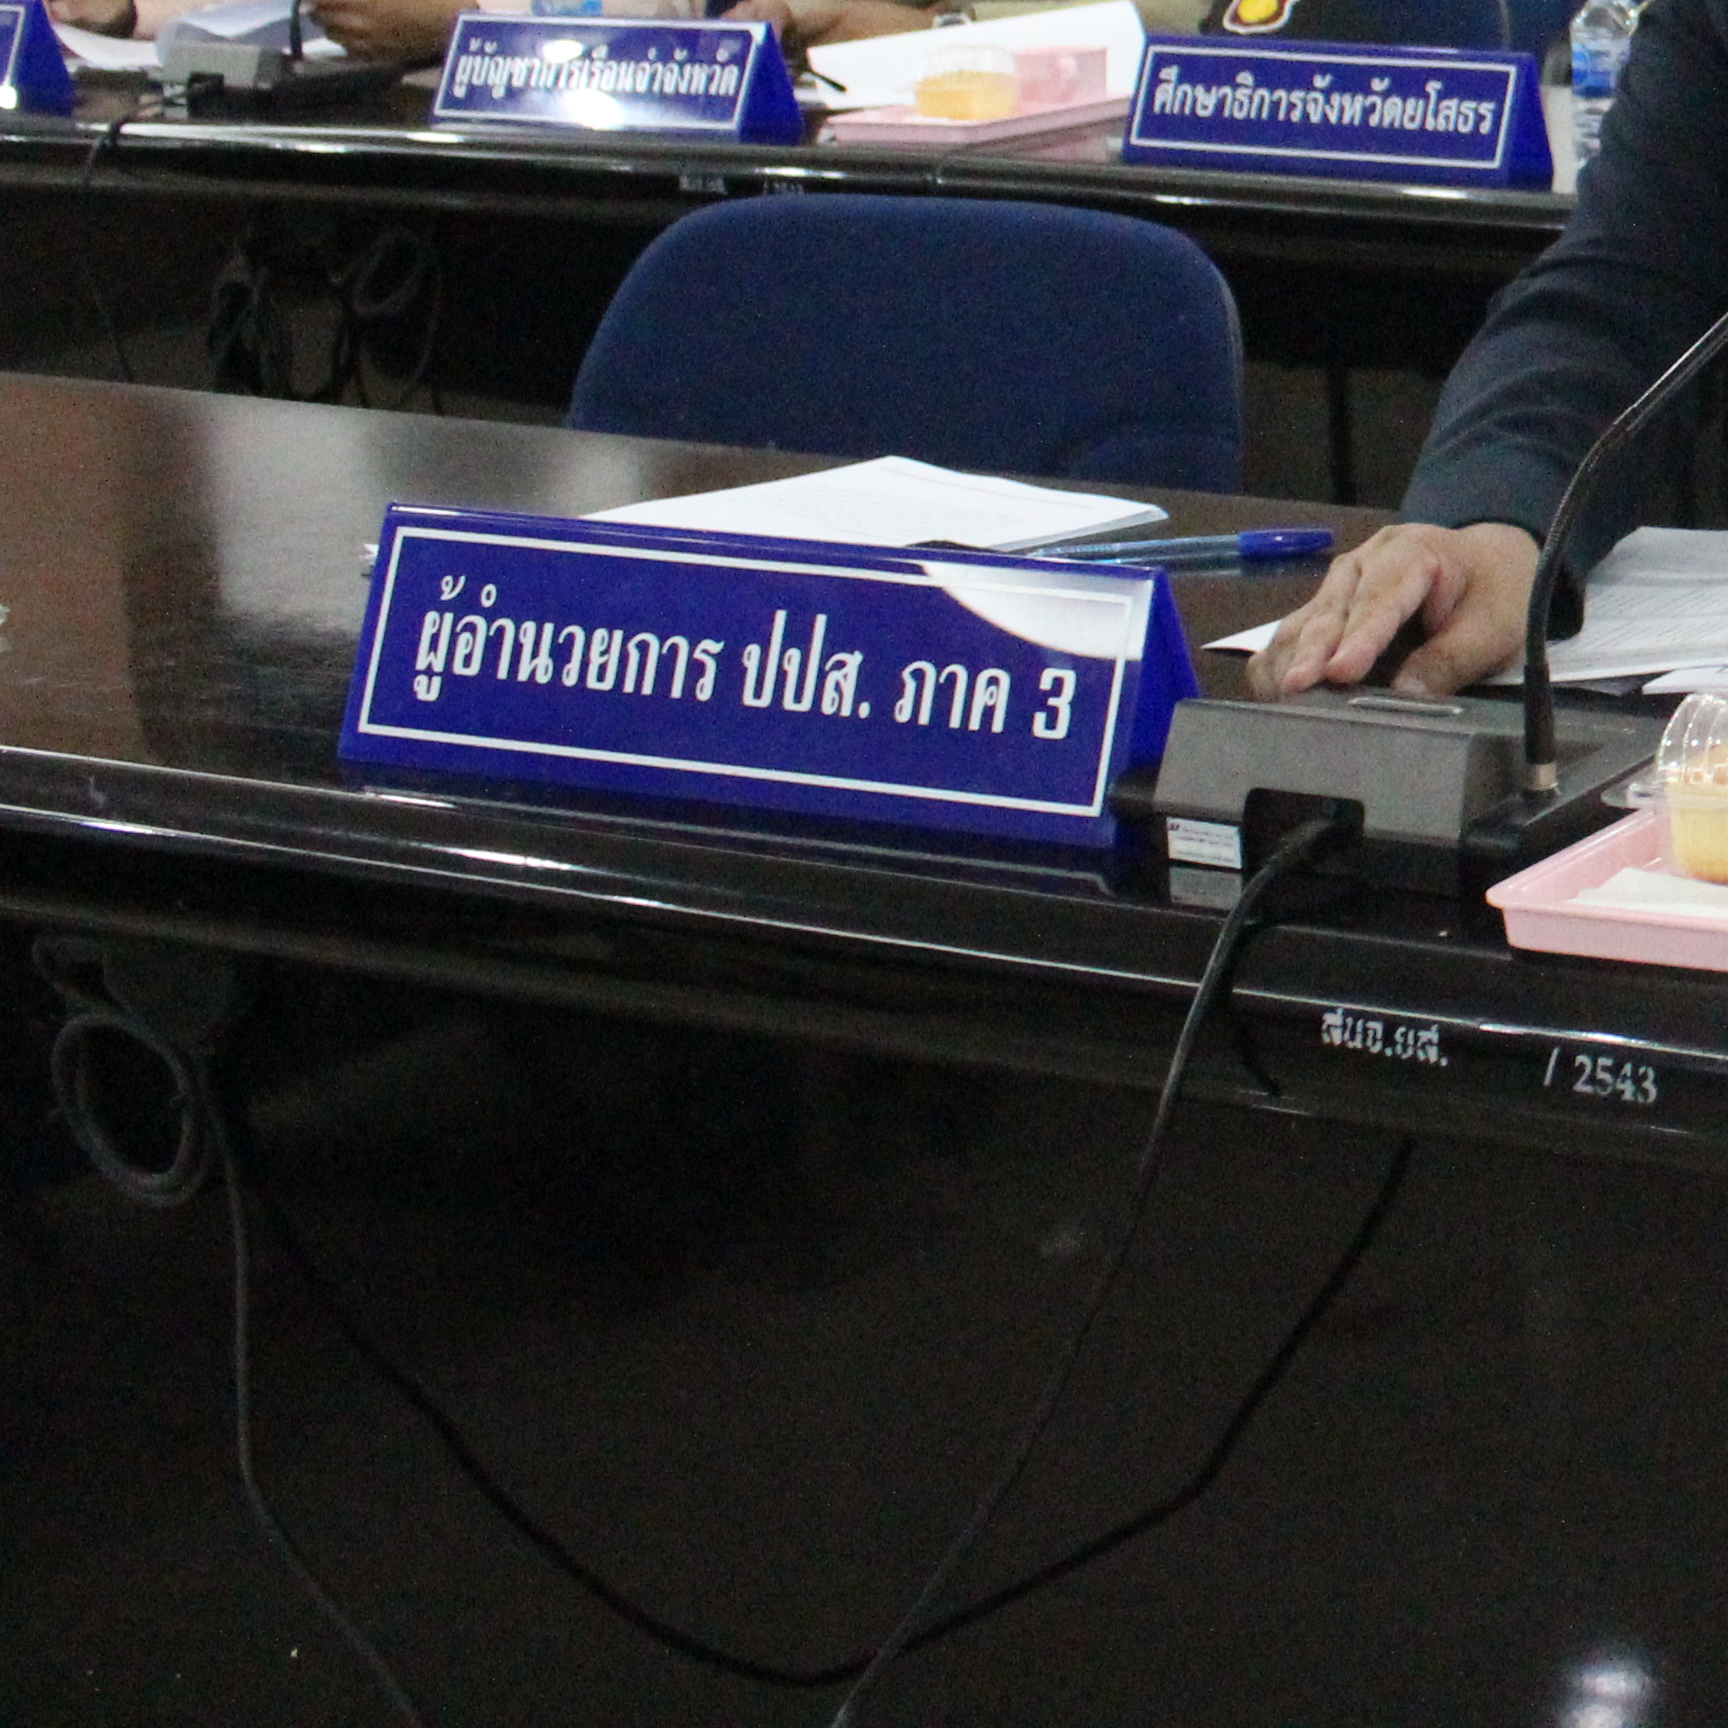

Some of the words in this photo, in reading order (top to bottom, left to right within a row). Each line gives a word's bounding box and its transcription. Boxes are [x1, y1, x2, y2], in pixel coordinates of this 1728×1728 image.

[453, 37, 739, 99] ผู้บัญชาการเรือนจำจังหวัด
[1152, 65, 1497, 135] ศึกษาธิการจังหวัดยโสธร
[413, 574, 723, 703] ผู้อำนวยการ
[742, 609, 871, 718] ปปส.
[894, 660, 1011, 734] ภาค
[1032, 666, 1077, 740] 3
